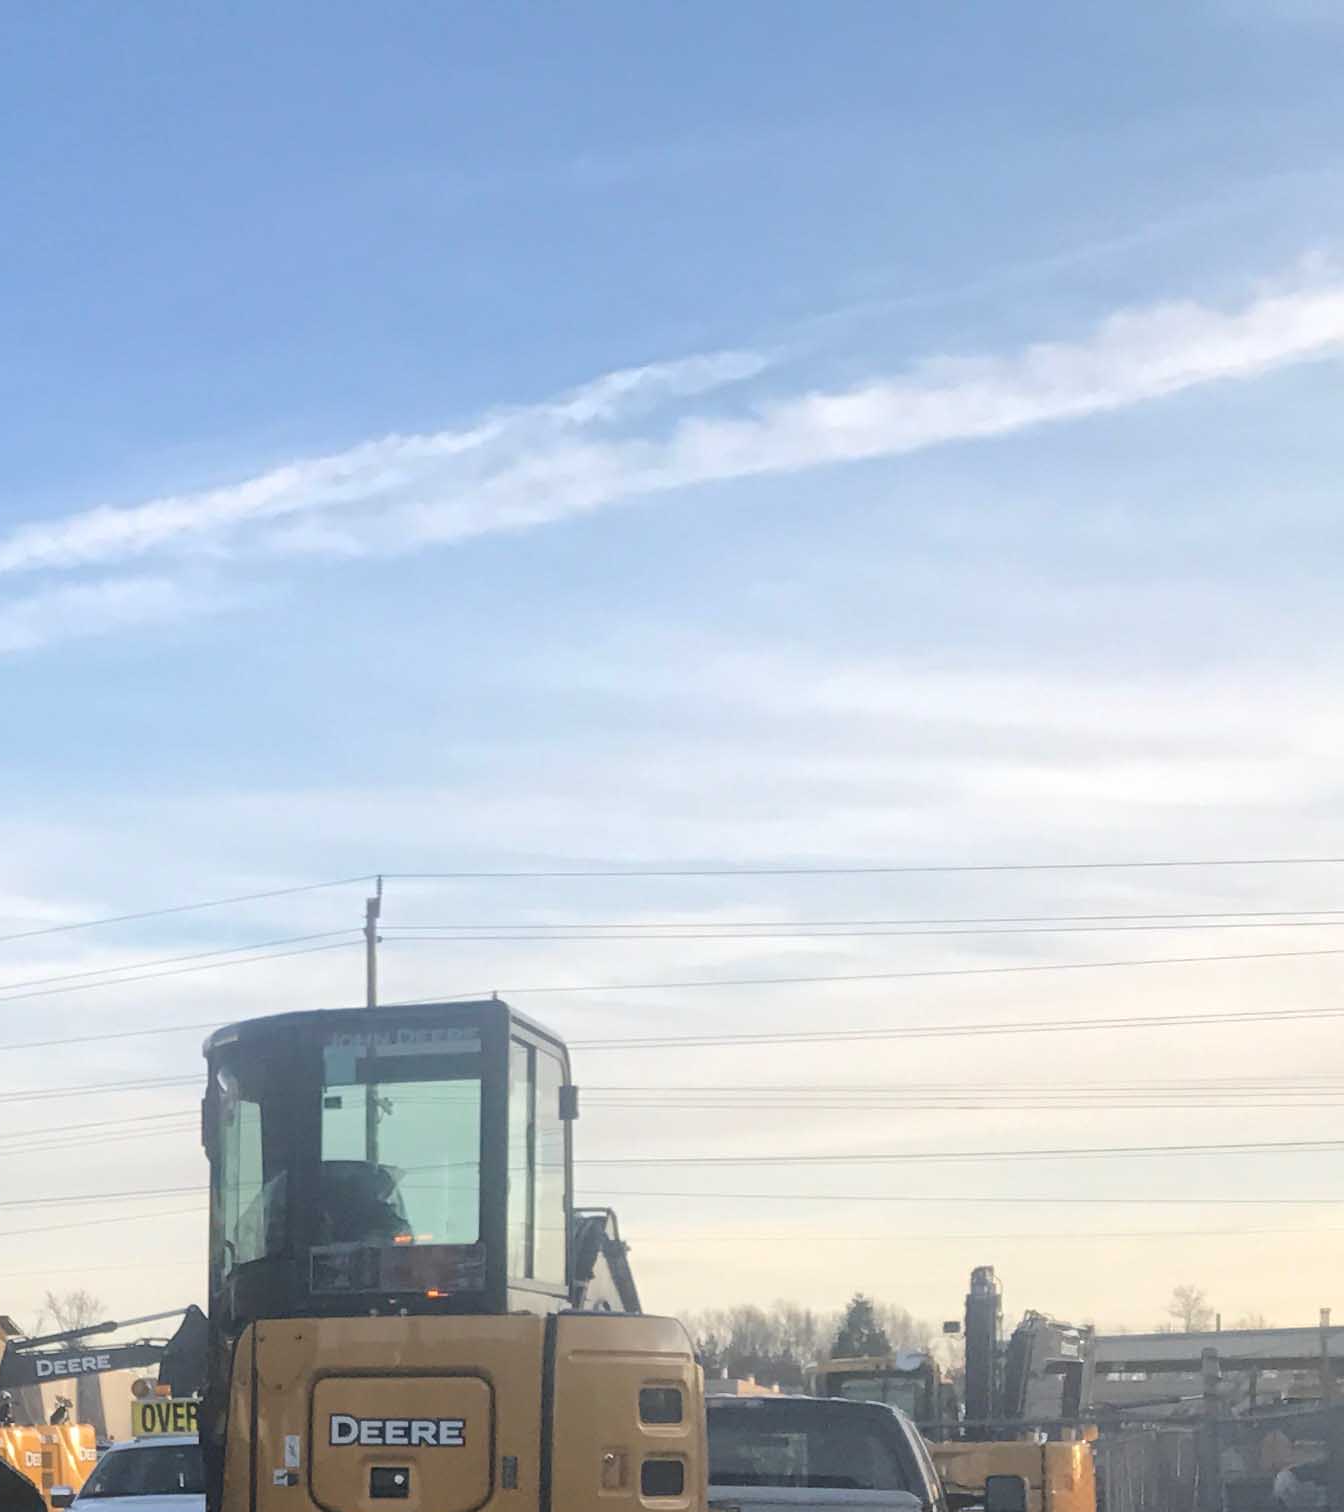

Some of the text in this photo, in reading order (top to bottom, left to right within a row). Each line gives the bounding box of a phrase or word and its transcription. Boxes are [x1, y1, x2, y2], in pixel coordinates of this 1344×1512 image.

[36, 1354, 111, 1377] DEERE
[141, 1401, 200, 1432] OVER
[331, 1415, 465, 1445] DEERE
